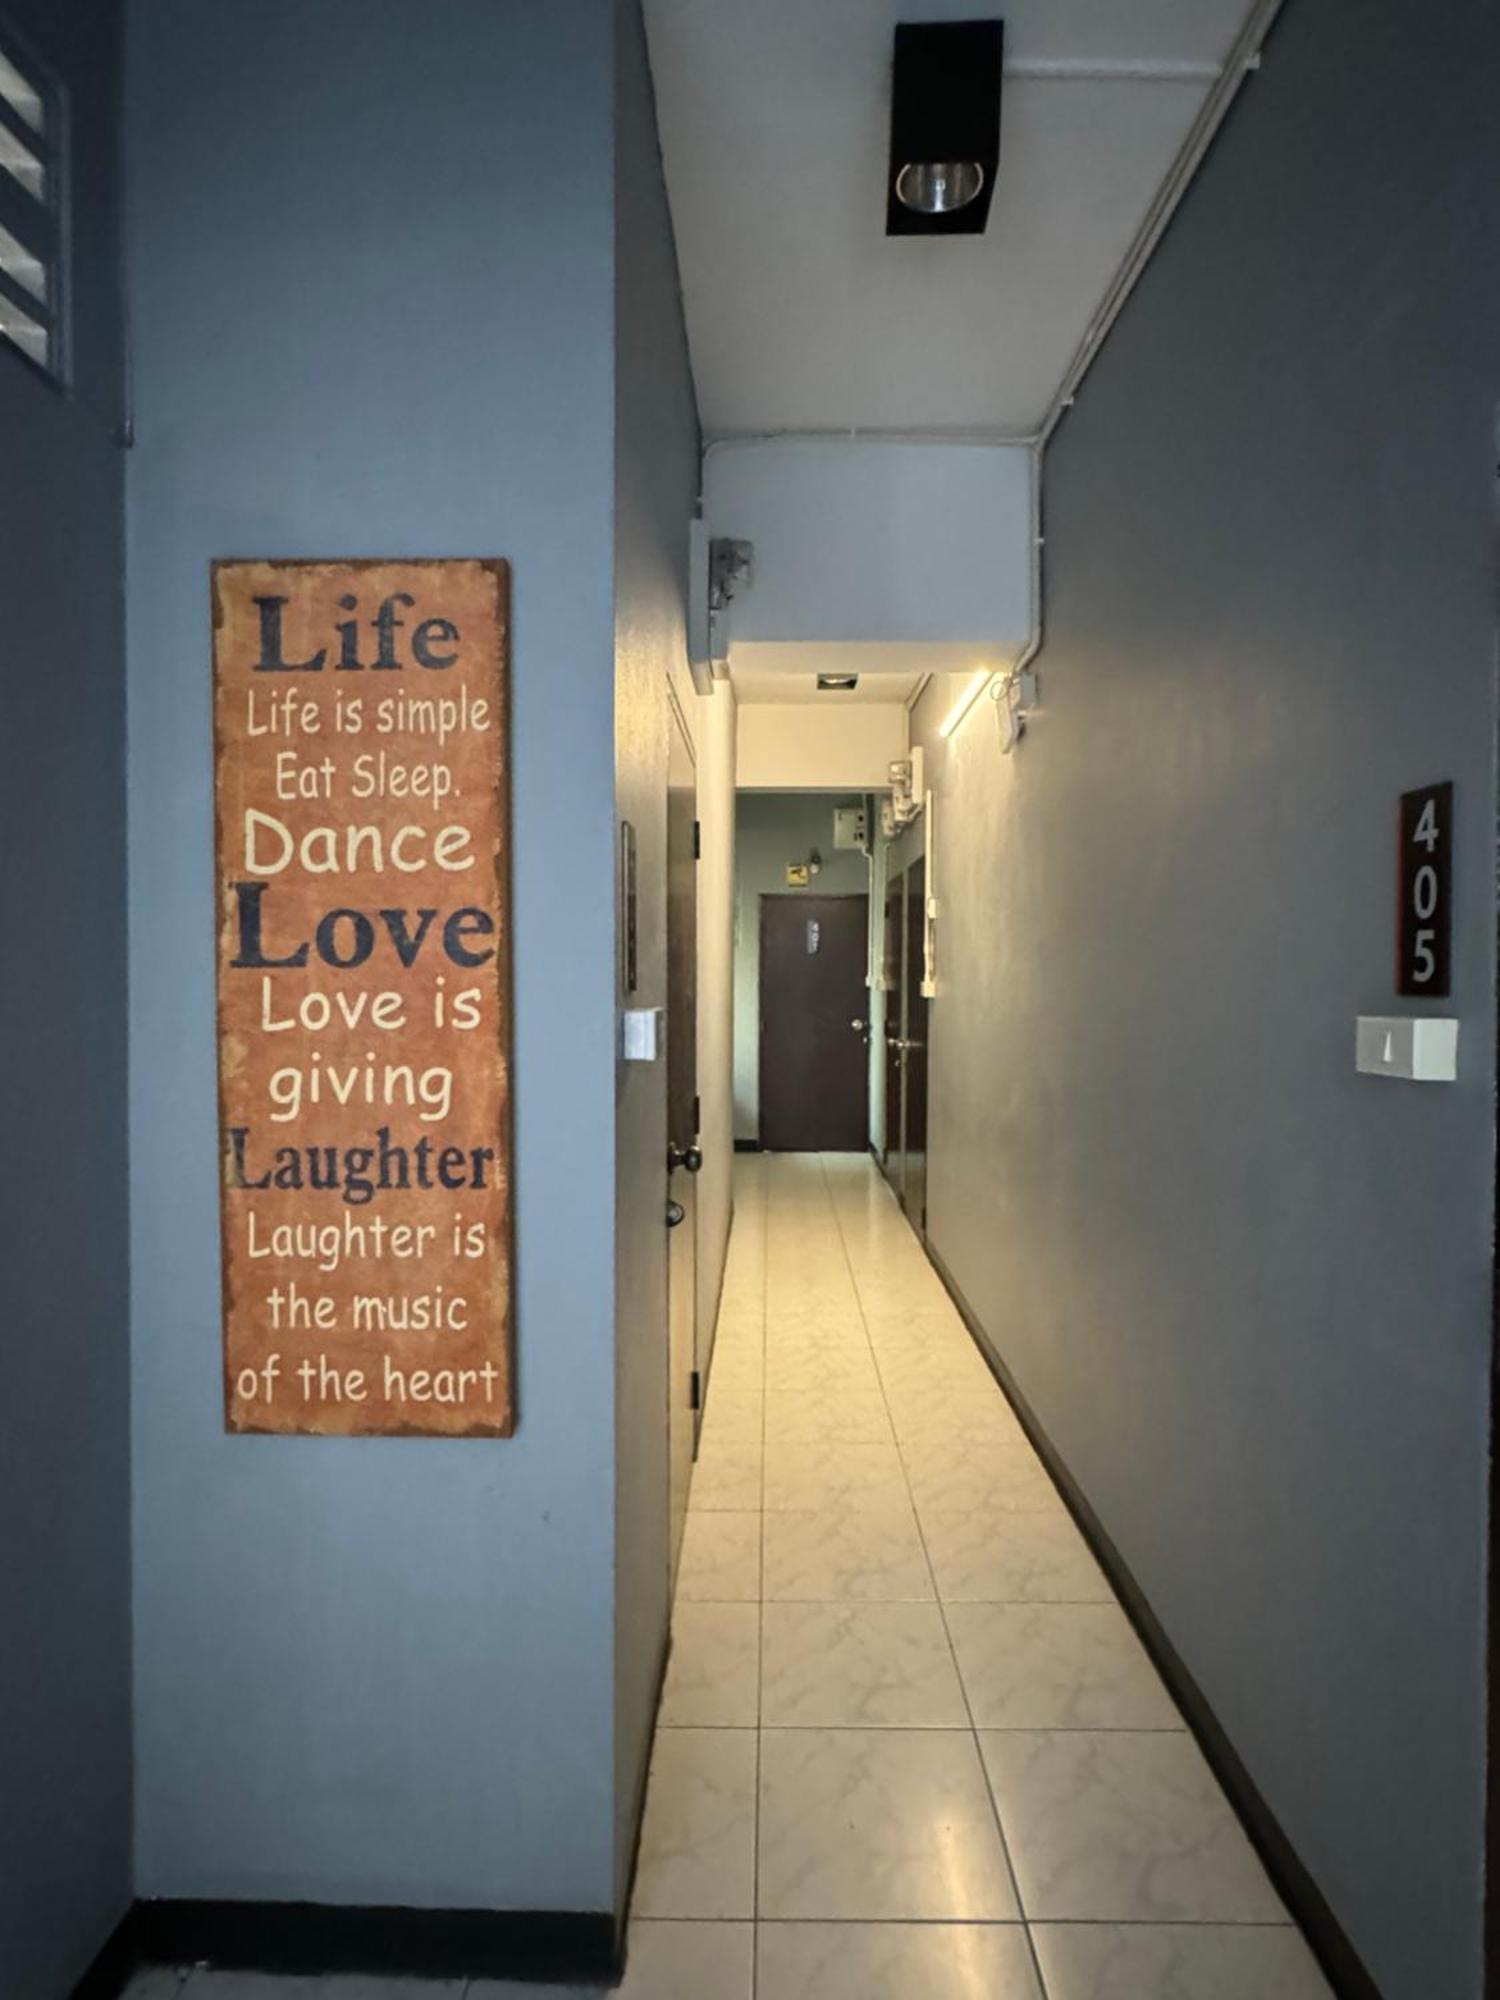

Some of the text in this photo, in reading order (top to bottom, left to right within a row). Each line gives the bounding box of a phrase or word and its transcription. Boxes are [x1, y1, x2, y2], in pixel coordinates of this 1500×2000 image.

[252, 593, 460, 672] Life
[247, 684, 491, 746] Life is simple
[276, 751, 460, 810] Eat Sleep.
[244, 807, 476, 875] Dance
[1412, 799, 1439, 983] 405
[228, 881, 495, 970] Love
[261, 976, 482, 1032] Love is
[269, 1052, 453, 1122] giving
[228, 1126, 494, 1205] Laughter
[247, 1210, 486, 1271] Laughter is
[266, 1282, 467, 1331] the music
[236, 1354, 499, 1404] of the heart
